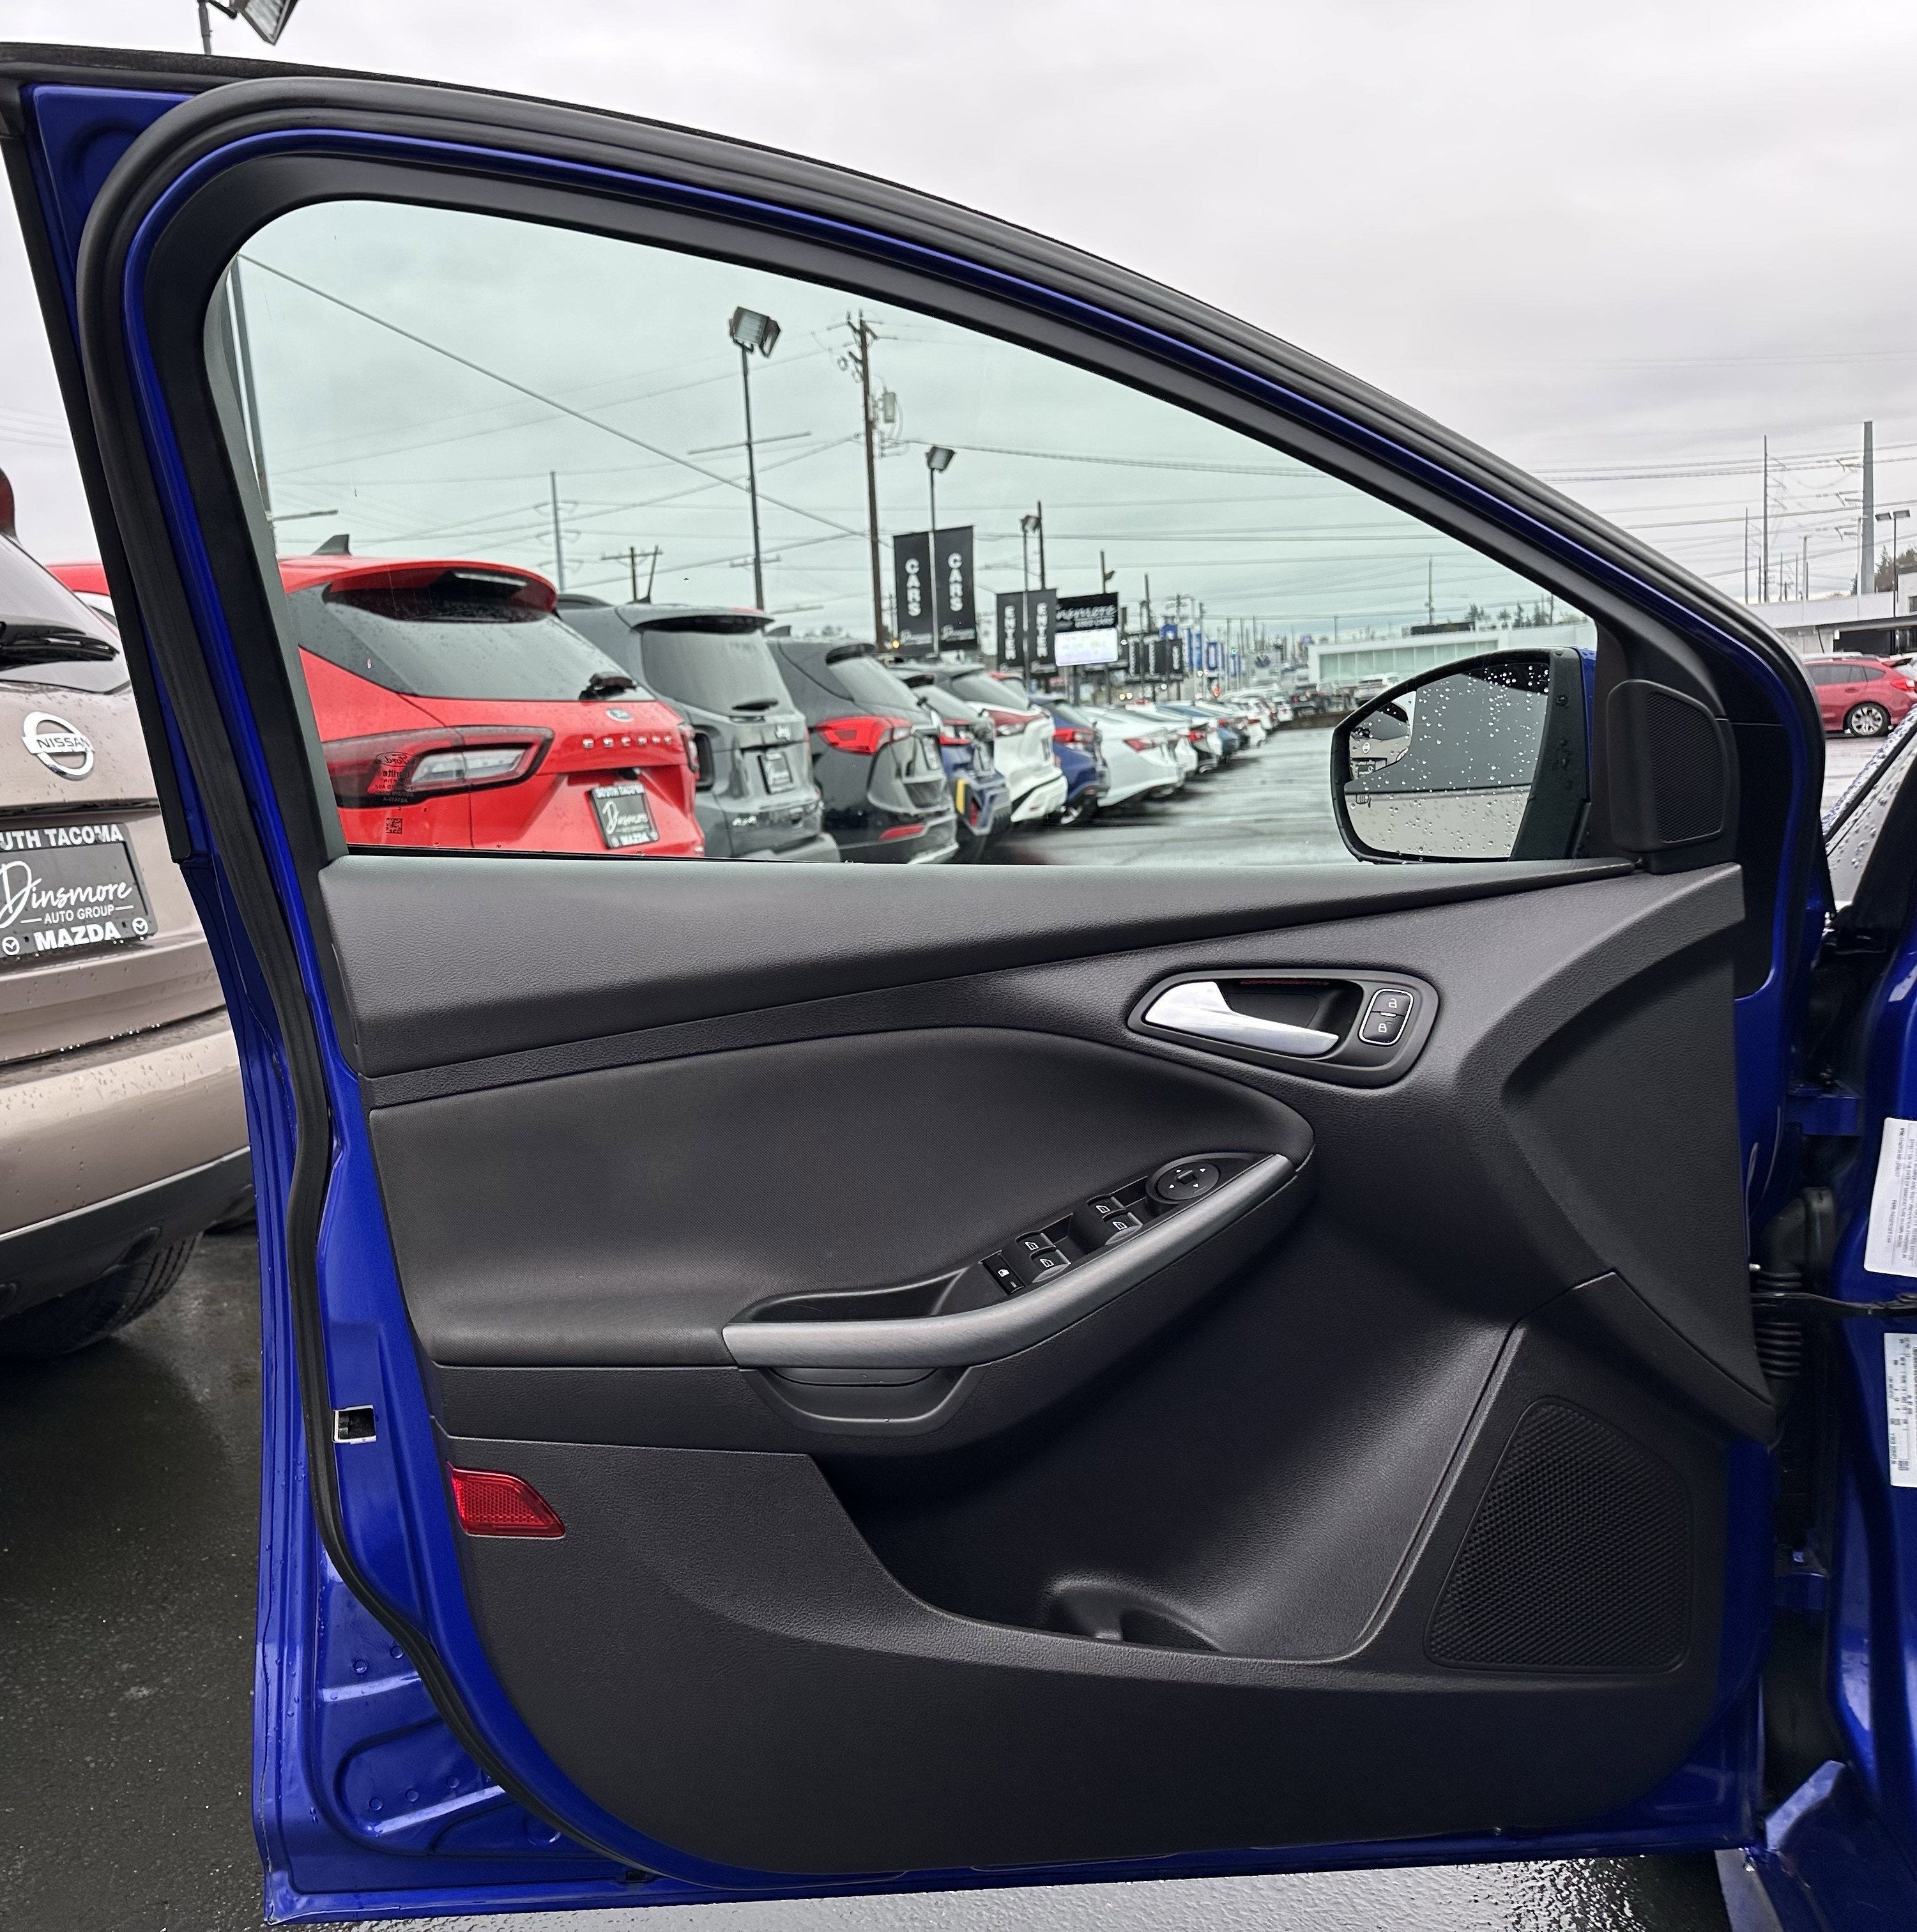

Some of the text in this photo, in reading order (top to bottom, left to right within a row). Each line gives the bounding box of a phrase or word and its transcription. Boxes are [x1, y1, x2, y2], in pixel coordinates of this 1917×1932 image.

[905, 558, 921, 617] CARS
[948, 553, 963, 611] CARS
[36, 737, 90, 749] NISSAN
[45, 824, 123, 847] TACOMA
[0, 861, 132, 929] Dinsmore
[45, 904, 114, 924] AUTO GROUP
[34, 921, 121, 951] MAZDA
